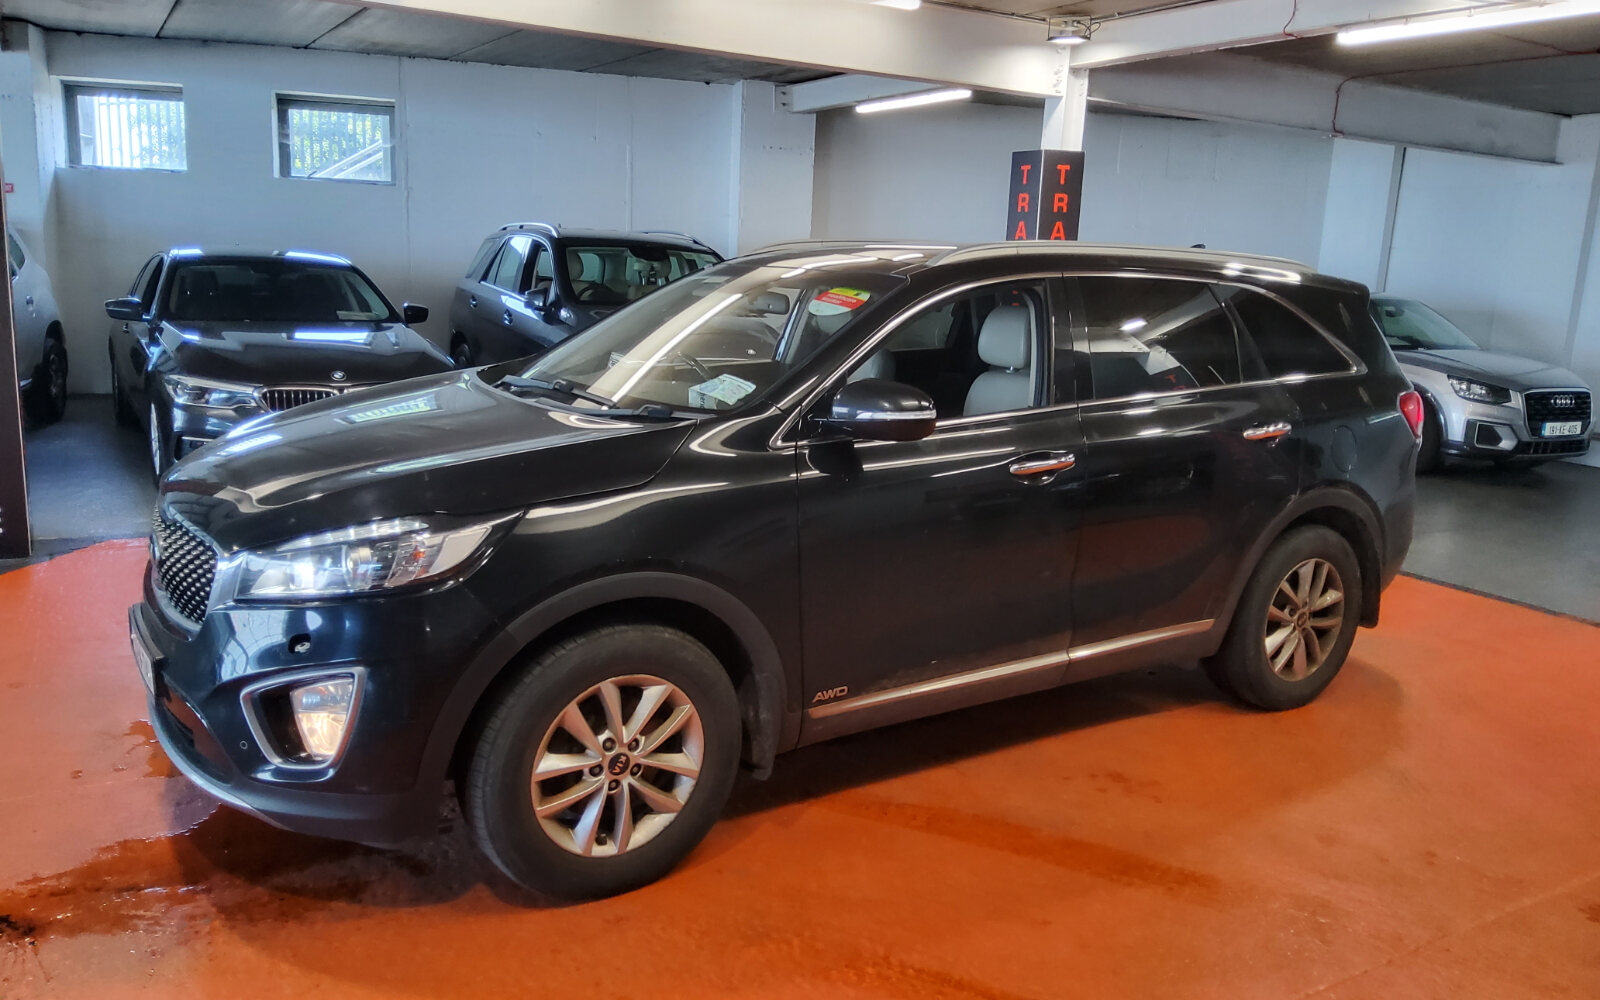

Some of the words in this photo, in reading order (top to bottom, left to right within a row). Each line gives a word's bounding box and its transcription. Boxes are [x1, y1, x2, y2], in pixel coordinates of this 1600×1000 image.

[1015, 164, 1031, 240] TRA
[1049, 164, 1071, 240] TRA
[812, 685, 849, 703] AWD
[612, 755, 627, 773] KIA
